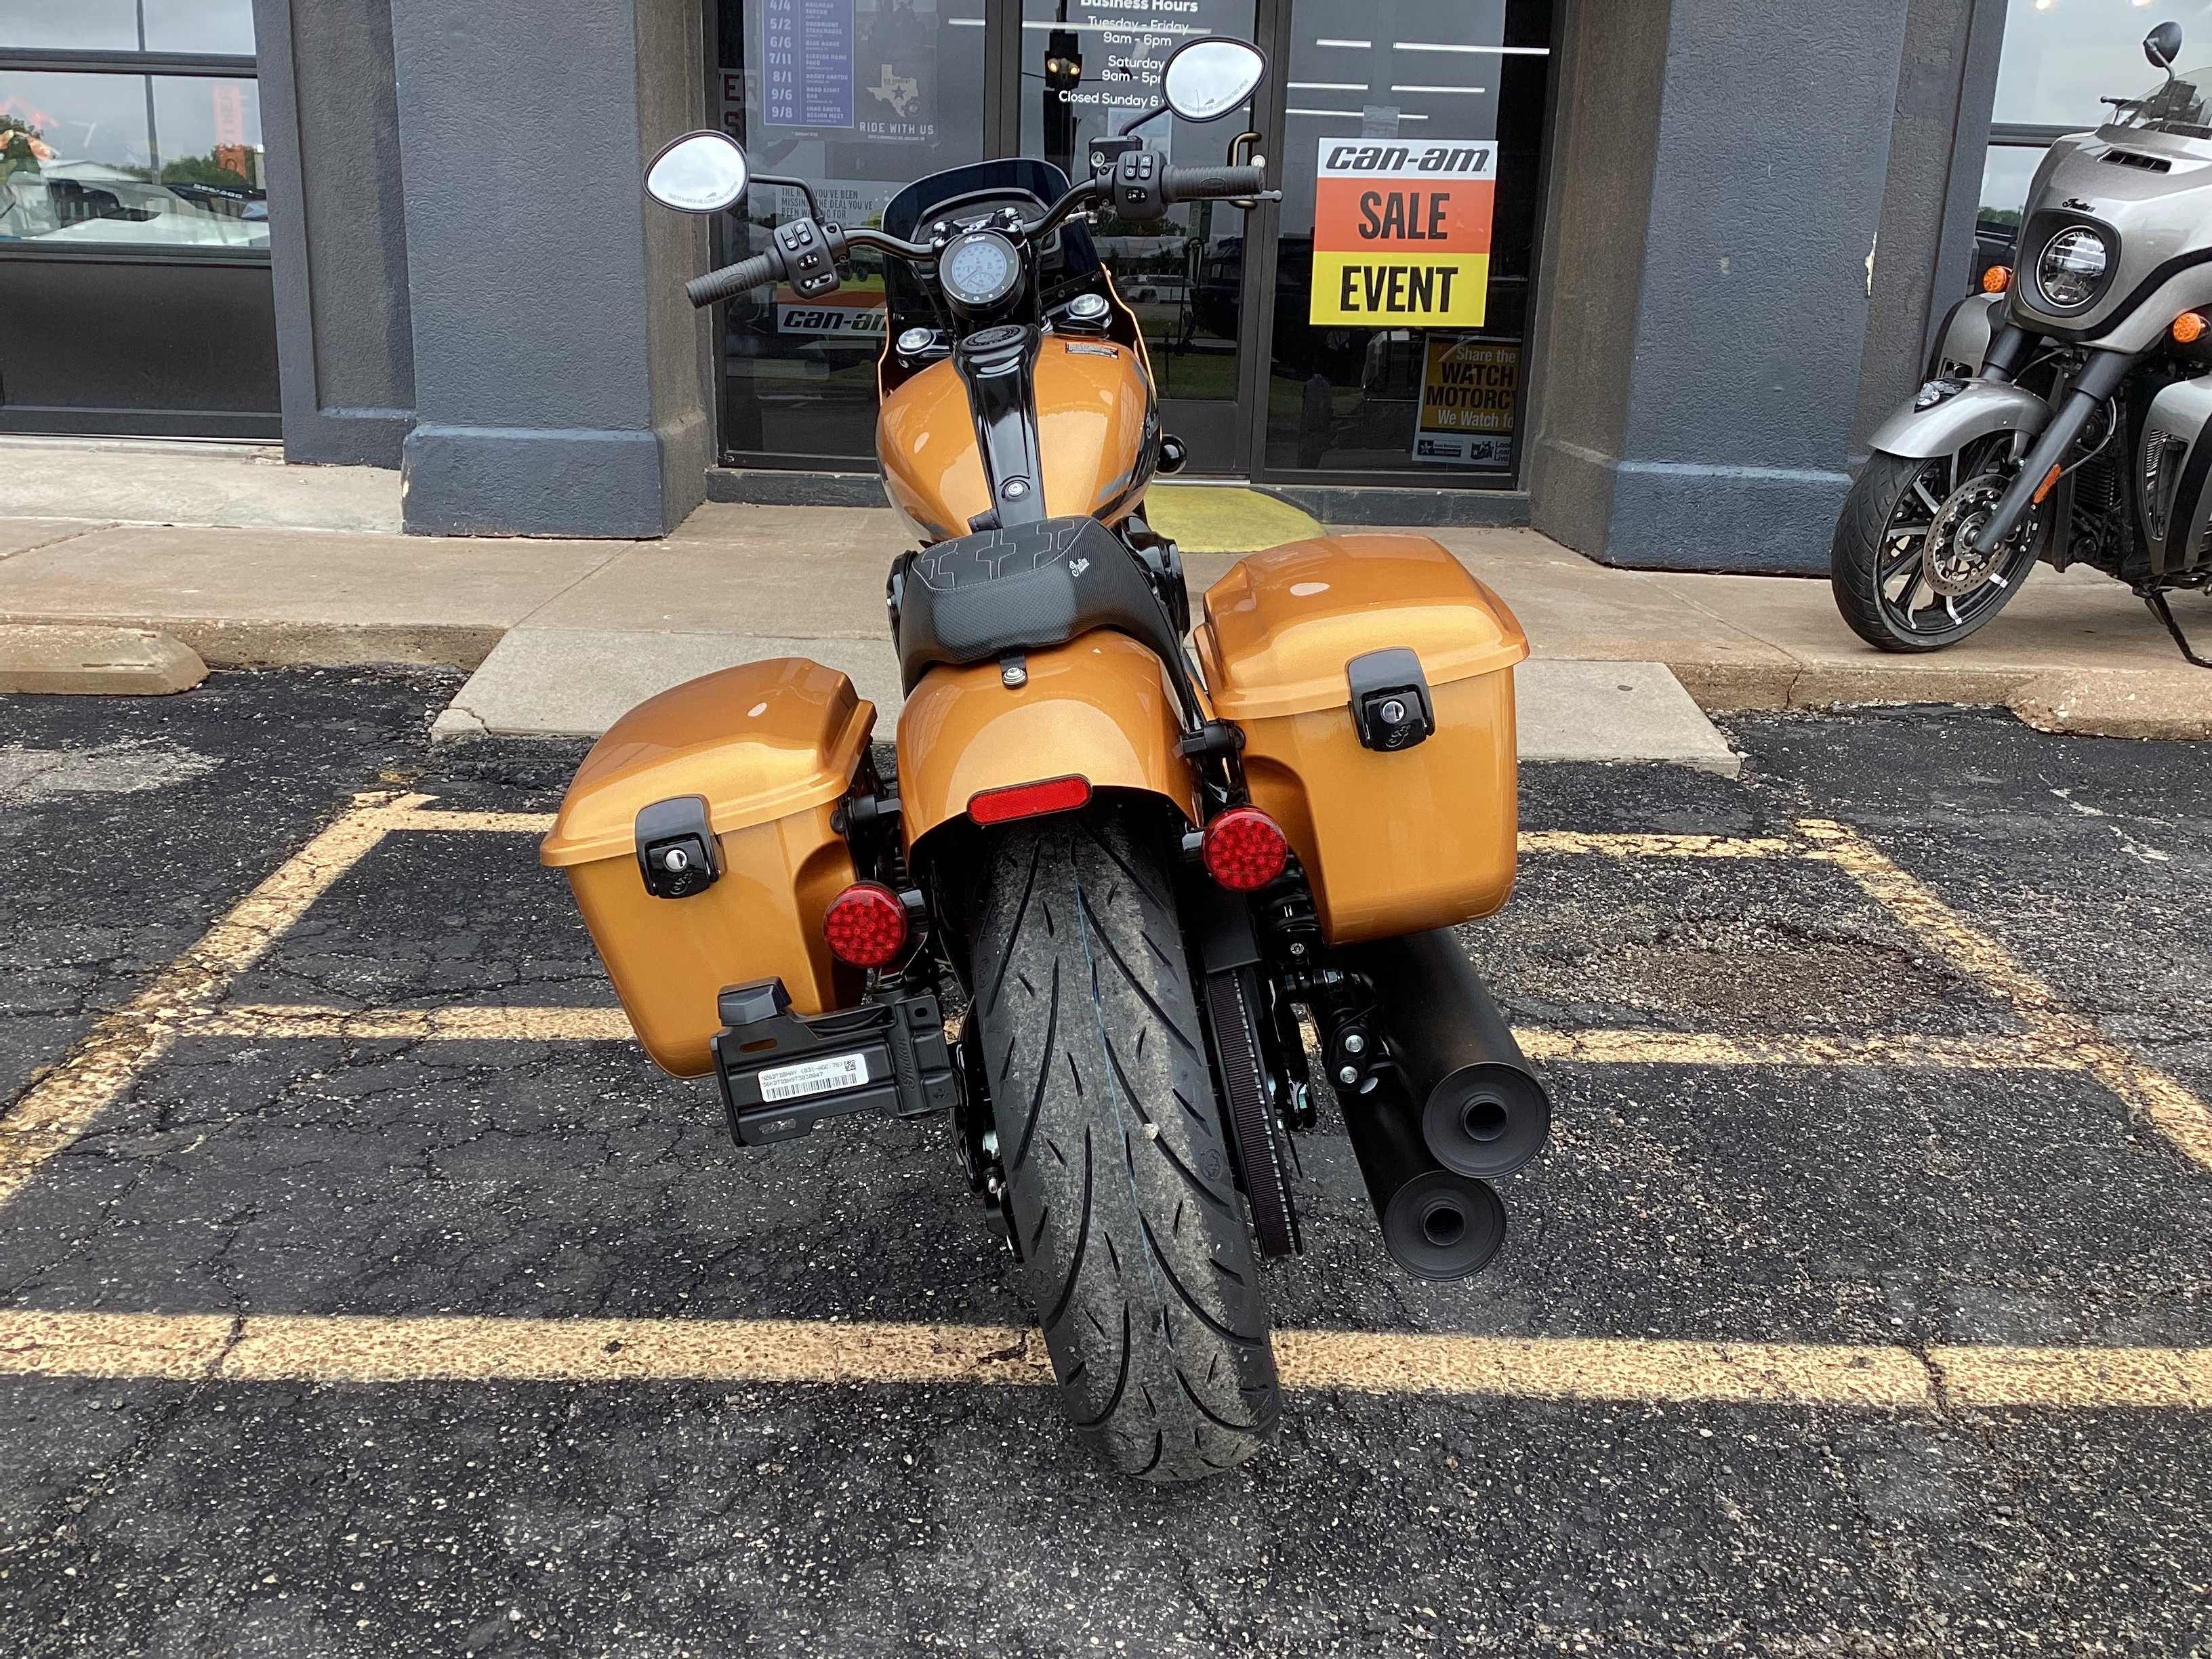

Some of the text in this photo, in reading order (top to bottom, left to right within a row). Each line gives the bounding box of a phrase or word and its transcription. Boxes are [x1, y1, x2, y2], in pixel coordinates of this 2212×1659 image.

[769, 0, 792, 11] 4/4
[1151, 0, 1198, 12] Hours
[770, 18, 792, 30] 5/2
[1087, 16, 1139, 33] Tuesday
[1150, 19, 1189, 35] Friday
[770, 36, 792, 48] 6/6
[1103, 31, 1132, 44] 9am
[1143, 34, 1172, 48] 6pm
[769, 52, 792, 64] 7/11
[1107, 55, 1166, 72] Saturday
[773, 70, 792, 83] 8/1
[1101, 69, 1130, 82] 9am
[771, 88, 792, 100] 9/6
[1059, 89, 1159, 109] Closed Sunday &
[772, 106, 792, 119] 9/8
[859, 122, 934, 135] RIDE WITH US
[781, 187, 794, 197] THE
[814, 188, 839, 199] YOU'VE
[840, 190, 858, 199] BEEN
[830, 199, 847, 209] DEAL
[848, 200, 873, 210] YOU'VE
[781, 207, 799, 217] BEEN
[1358, 191, 1450, 240] SALE
[1340, 265, 1458, 312] EVENT
[1456, 346, 1516, 363] Share the
[1441, 362, 1515, 388] WATCH
[1438, 409, 1456, 425] We
[1460, 411, 1499, 428] Watch
